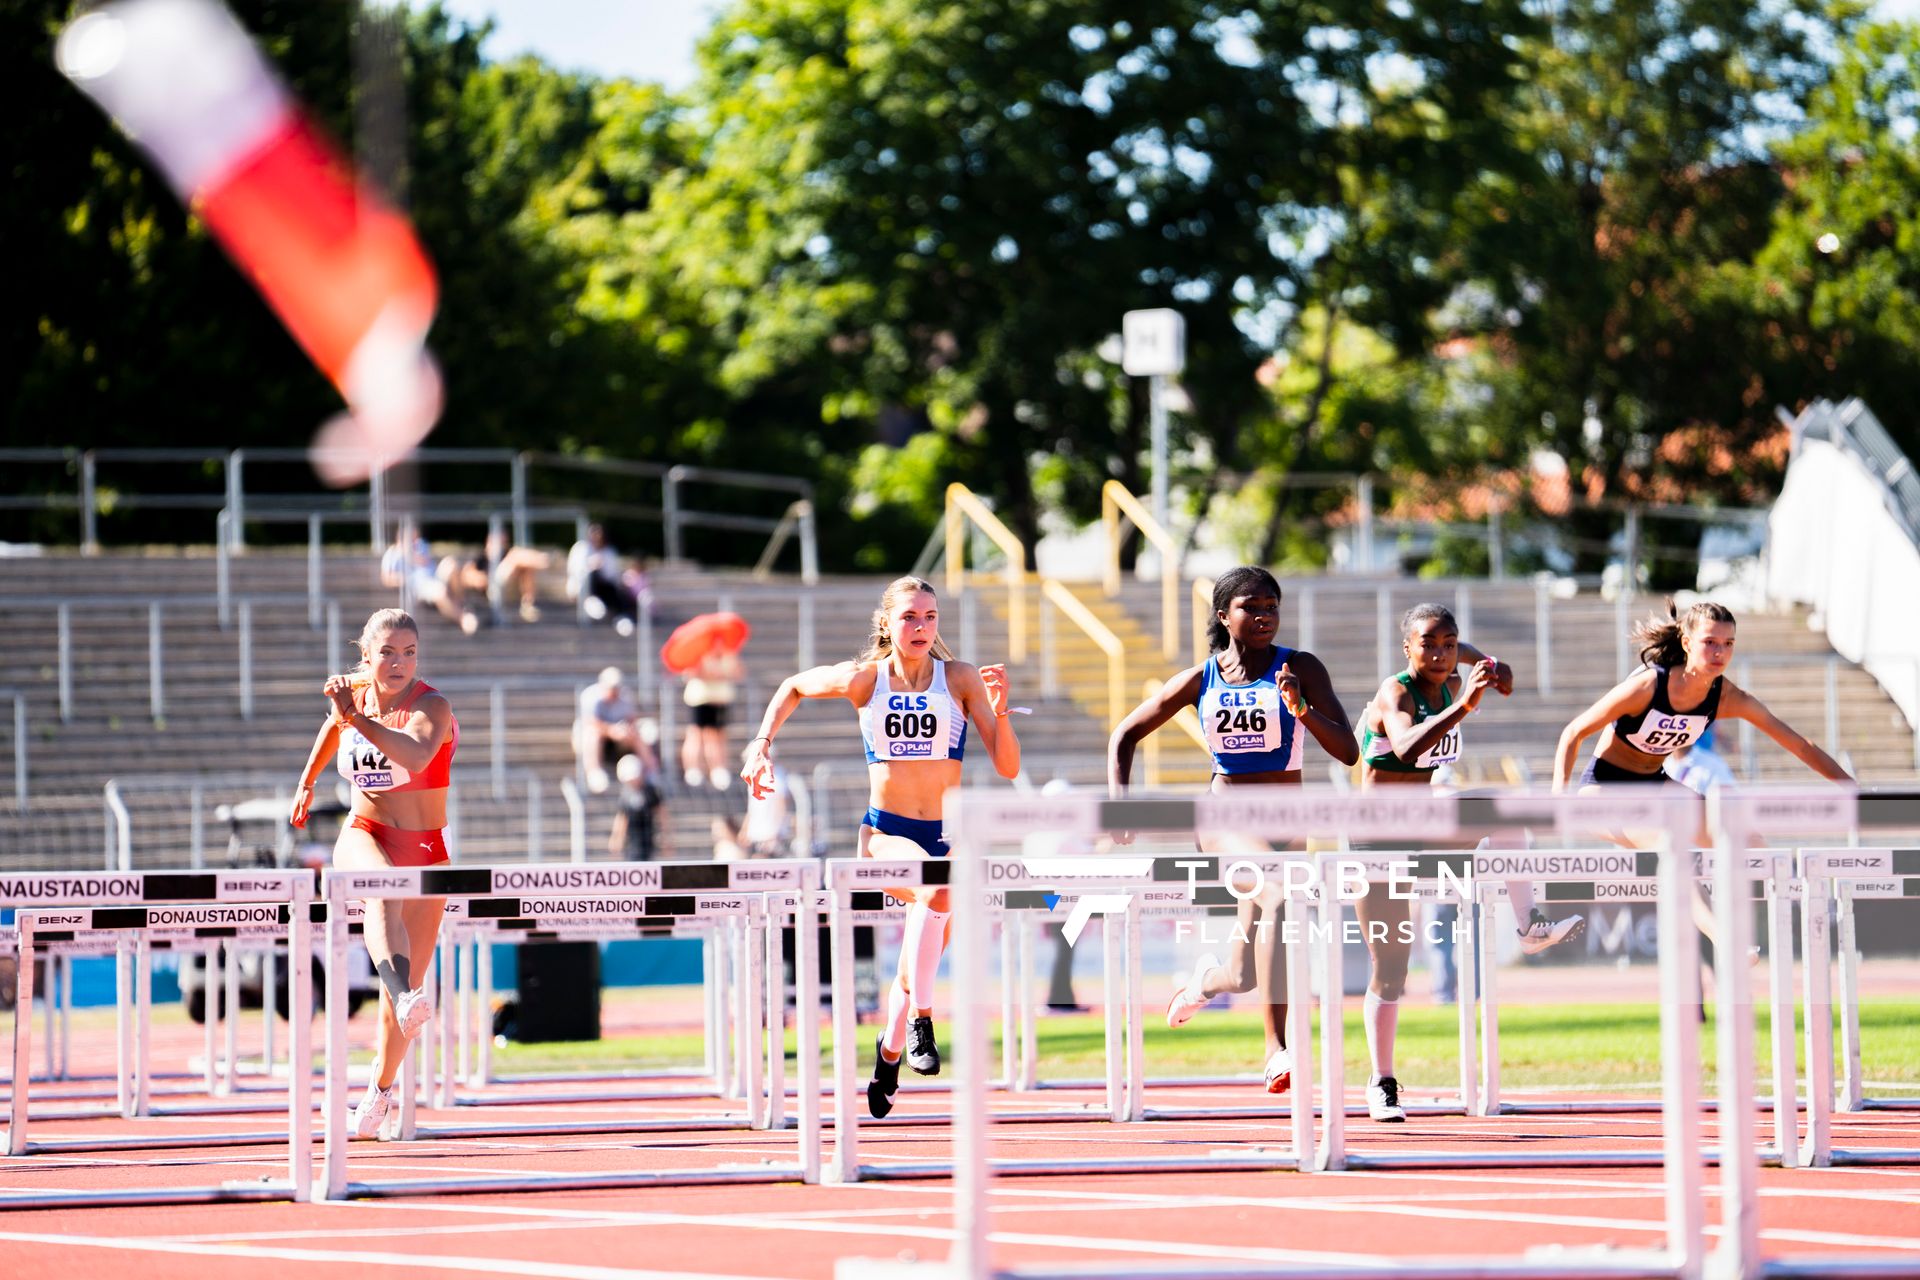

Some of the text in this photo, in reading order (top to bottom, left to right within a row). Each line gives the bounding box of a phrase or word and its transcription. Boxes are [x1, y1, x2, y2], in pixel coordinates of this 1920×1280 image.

[885, 713, 937, 738] 609
[1216, 708, 1266, 733] 246
[1430, 731, 1458, 757] 201
[1645, 730, 1690, 747] 678
[907, 743, 931, 751] PLAN
[349, 748, 393, 770] 142
[370, 774, 391, 782] PLAN
[1477, 856, 1633, 874] DONAUSTADION
[1828, 858, 1882, 868] BENZ
[495, 869, 657, 889] DONAUSTADION
[736, 870, 790, 881] BENZ
[856, 868, 910, 878] BENZ
[224, 881, 282, 892] BENZ
[352, 877, 410, 888] BENZ
[1597, 884, 1658, 897] DONAUS
[1144, 893, 1183, 901] BENZ
[522, 901, 643, 914] DONAUSTADION
[700, 901, 741, 909] BENZ
[38, 915, 83, 925] BENZ
[149, 908, 277, 924] DONAUSTADION
